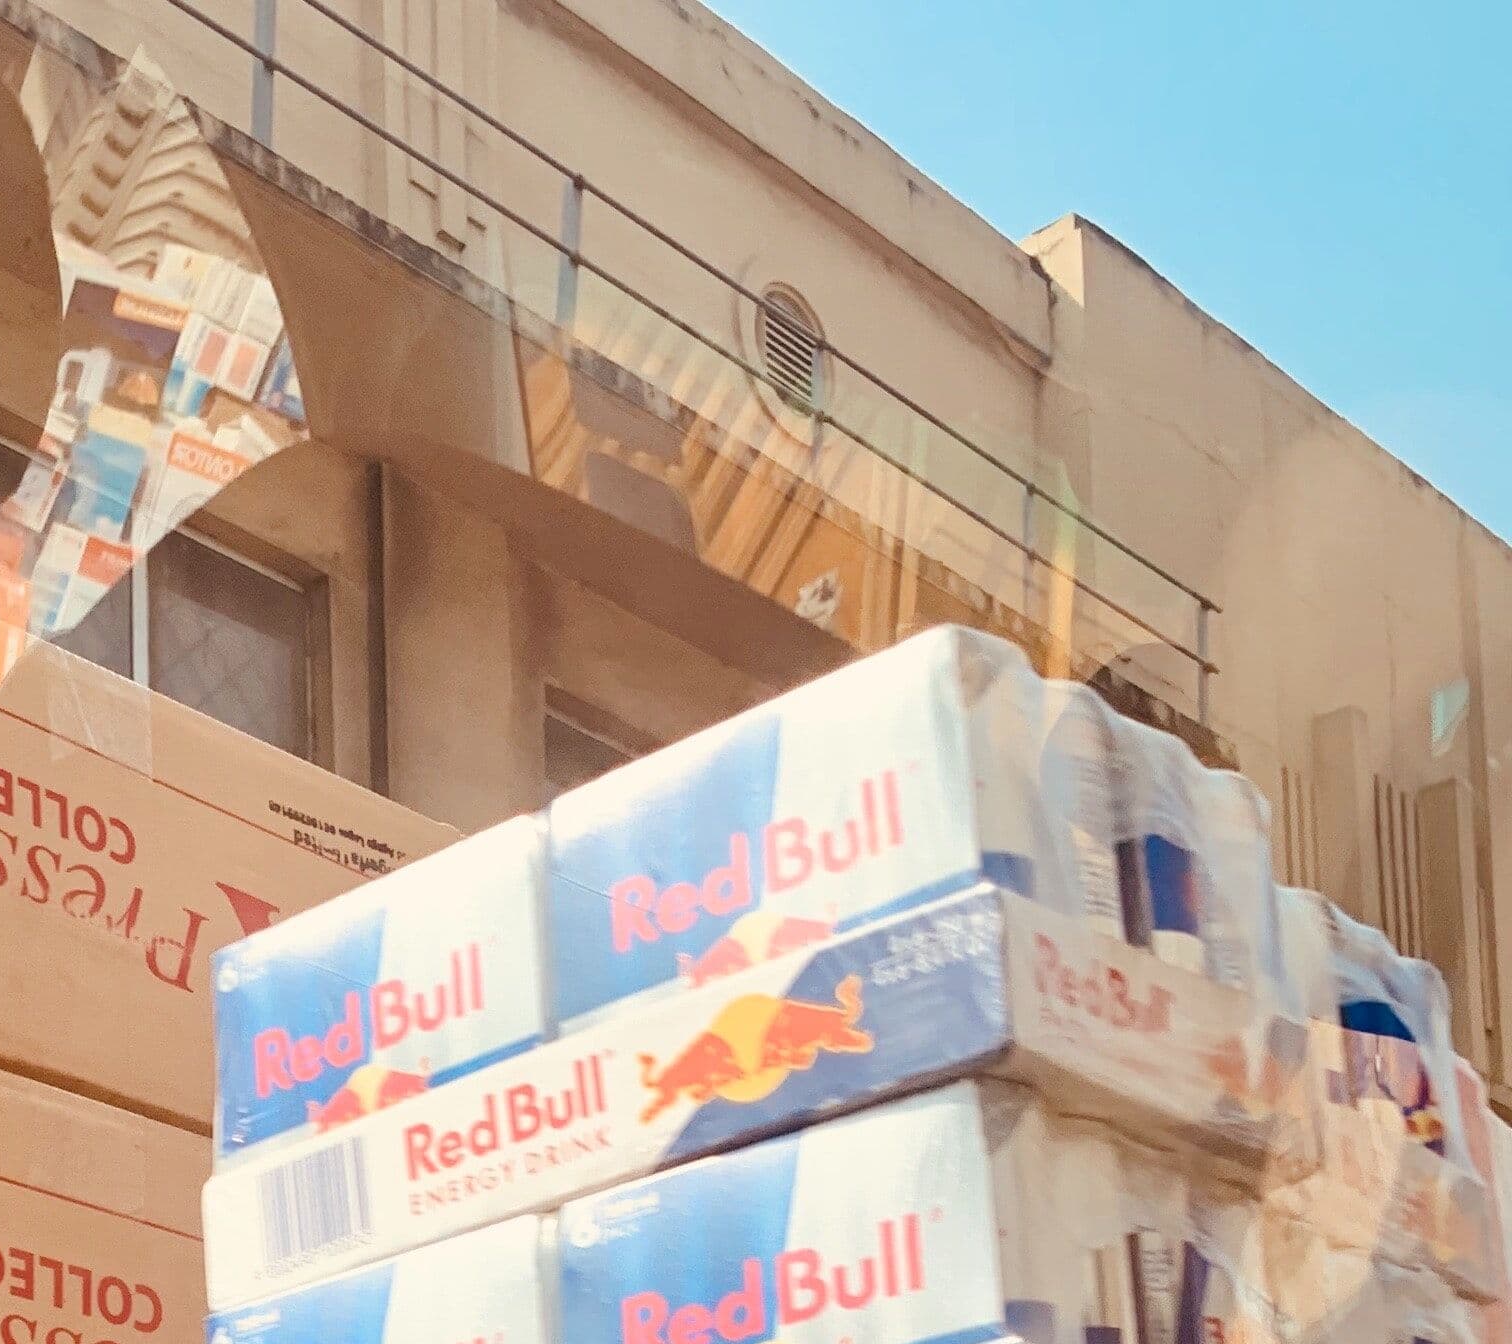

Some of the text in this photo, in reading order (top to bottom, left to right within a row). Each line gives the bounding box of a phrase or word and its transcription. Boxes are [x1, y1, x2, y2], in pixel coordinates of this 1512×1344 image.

[609, 831, 752, 955] Red
[760, 769, 906, 896] Bull
[253, 942, 485, 1099] Red Bull
[402, 1053, 610, 1182] Red Bull
[406, 1125, 614, 1218] ENERGY DRINK
[776, 1213, 927, 1327] Bull
